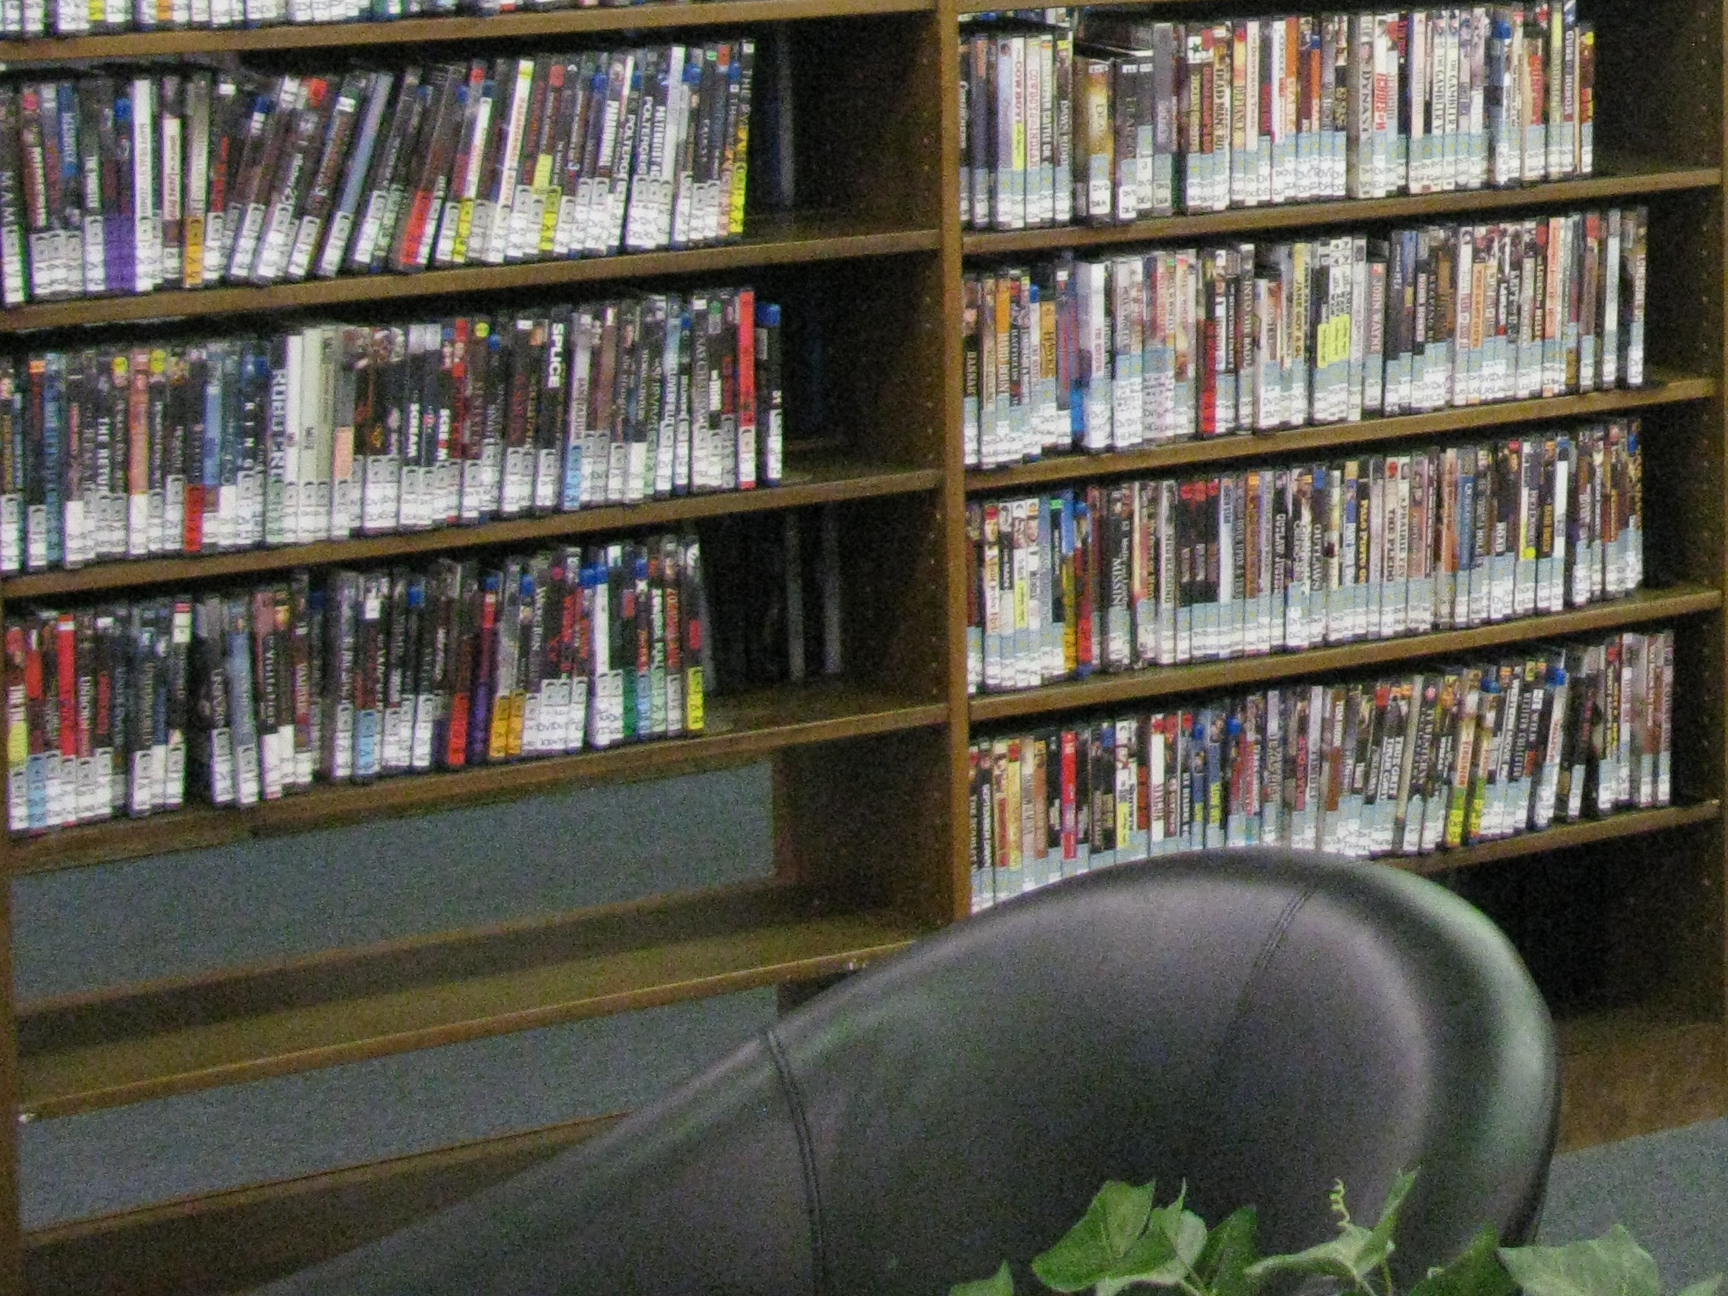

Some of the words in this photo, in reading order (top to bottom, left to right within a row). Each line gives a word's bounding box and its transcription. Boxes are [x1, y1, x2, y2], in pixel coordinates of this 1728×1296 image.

[1432, 70, 1444, 122] GAMBLER
[1371, 279, 1383, 309] JOHN
[1371, 311, 1383, 348] WAYNE
[547, 321, 564, 389] SPLICE
[407, 402, 420, 457] SCREAM
[1311, 523, 1322, 590] OUTLAWS
[1391, 736, 1403, 764] TRUE
[1388, 767, 1400, 796] GRIT
